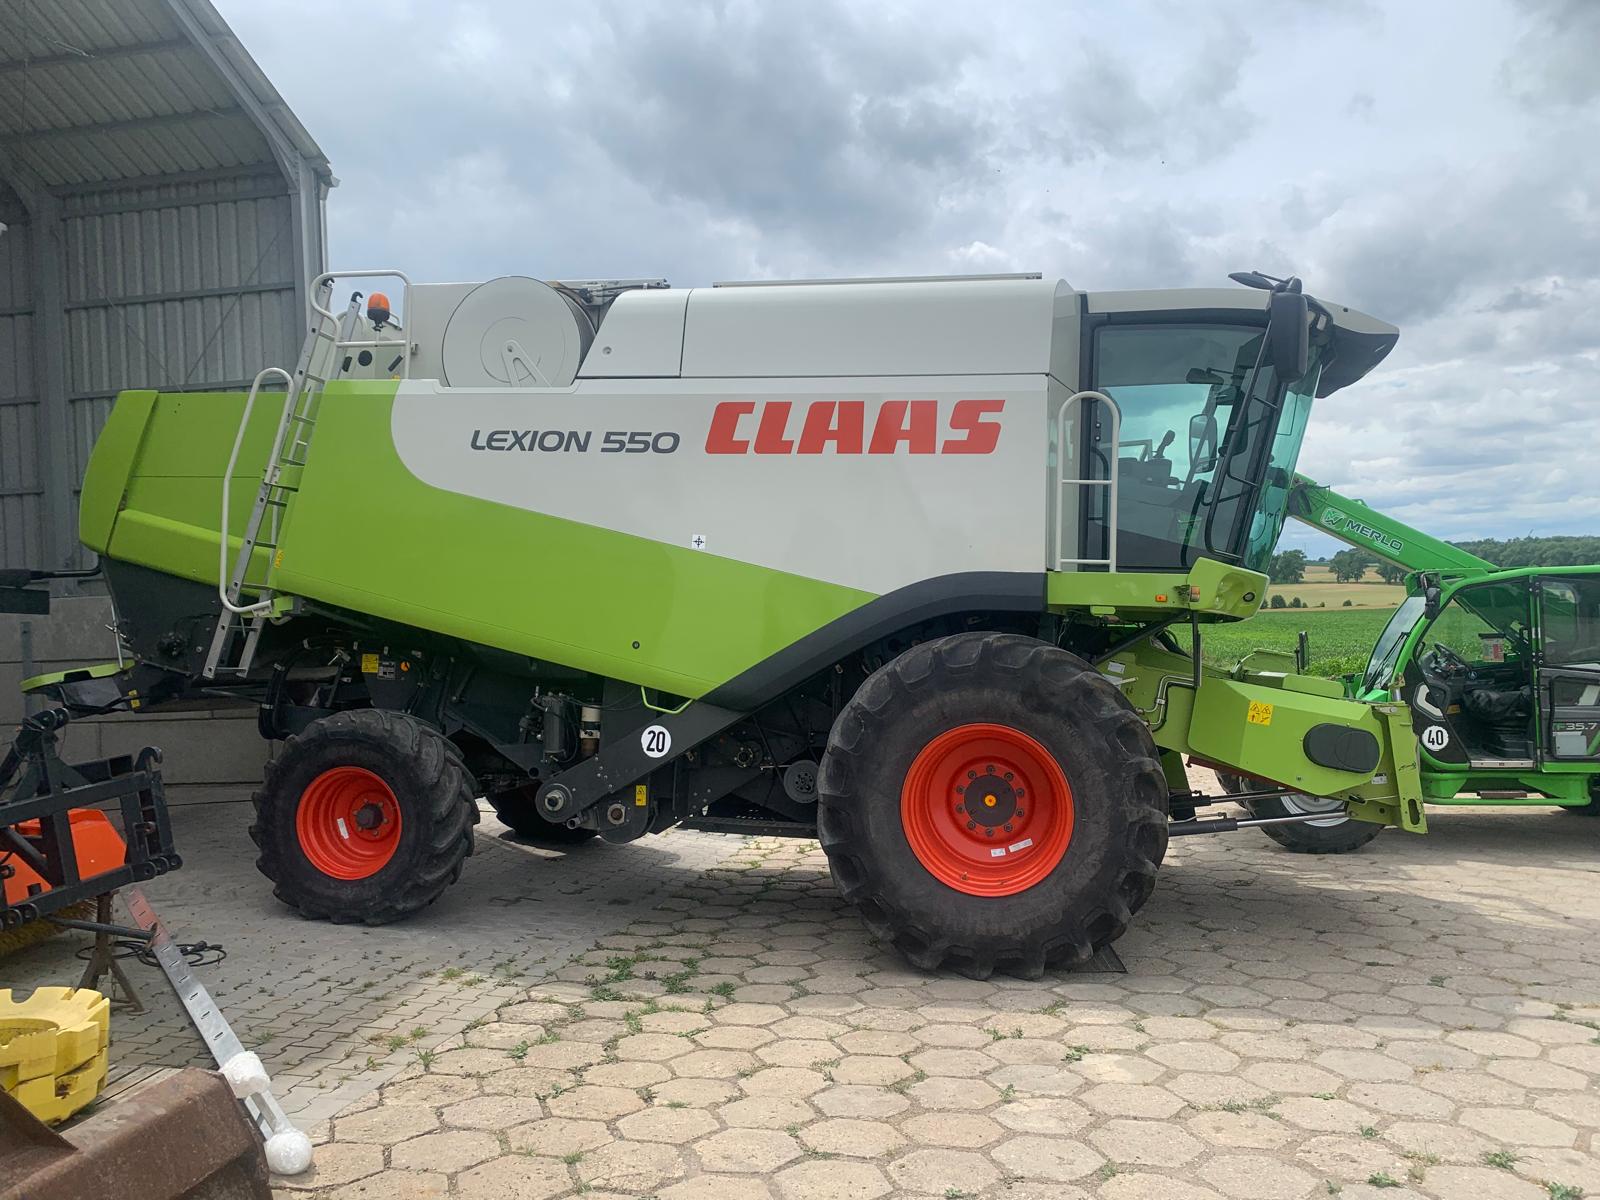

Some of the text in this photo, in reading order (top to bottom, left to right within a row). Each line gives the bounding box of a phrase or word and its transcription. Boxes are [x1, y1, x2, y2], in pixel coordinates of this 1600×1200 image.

[705, 399, 1006, 454] CLAAS
[470, 429, 680, 454] LEXION 550
[1346, 519, 1404, 551] MERLO
[646, 730, 665, 752] 20
[1428, 729, 1444, 746] 40
